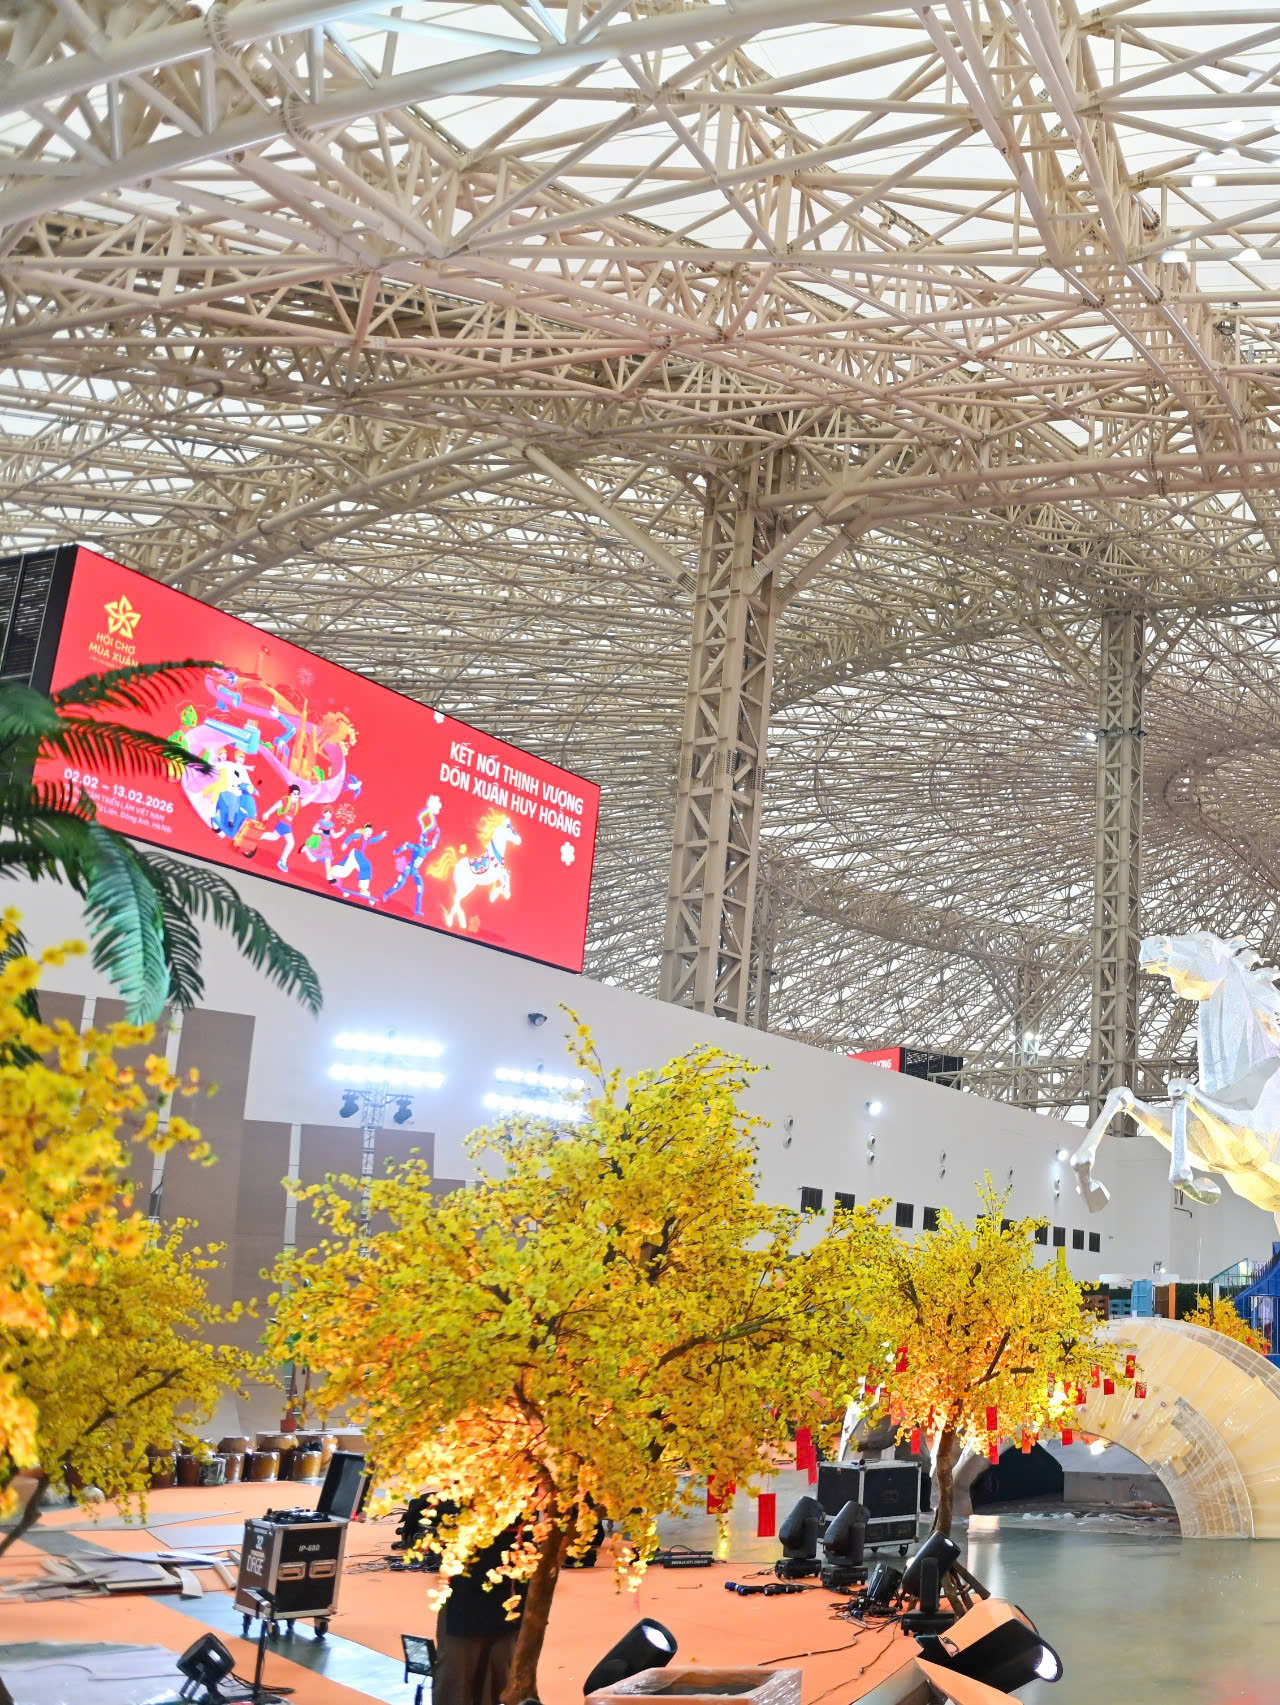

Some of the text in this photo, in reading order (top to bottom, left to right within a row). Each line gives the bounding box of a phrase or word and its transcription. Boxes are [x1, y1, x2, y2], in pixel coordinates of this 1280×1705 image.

[64, 768, 99, 789] 02.02
[113, 784, 174, 814] 13.02.2026
[440, 763, 582, 838] ĐÓN XUÂN HUY HOÀNG
[450, 741, 585, 816] KẾT NỐI THỊNH VƯỢNG
[256, 1535, 264, 1549] 32
[299, 1544, 321, 1552] IP-680
